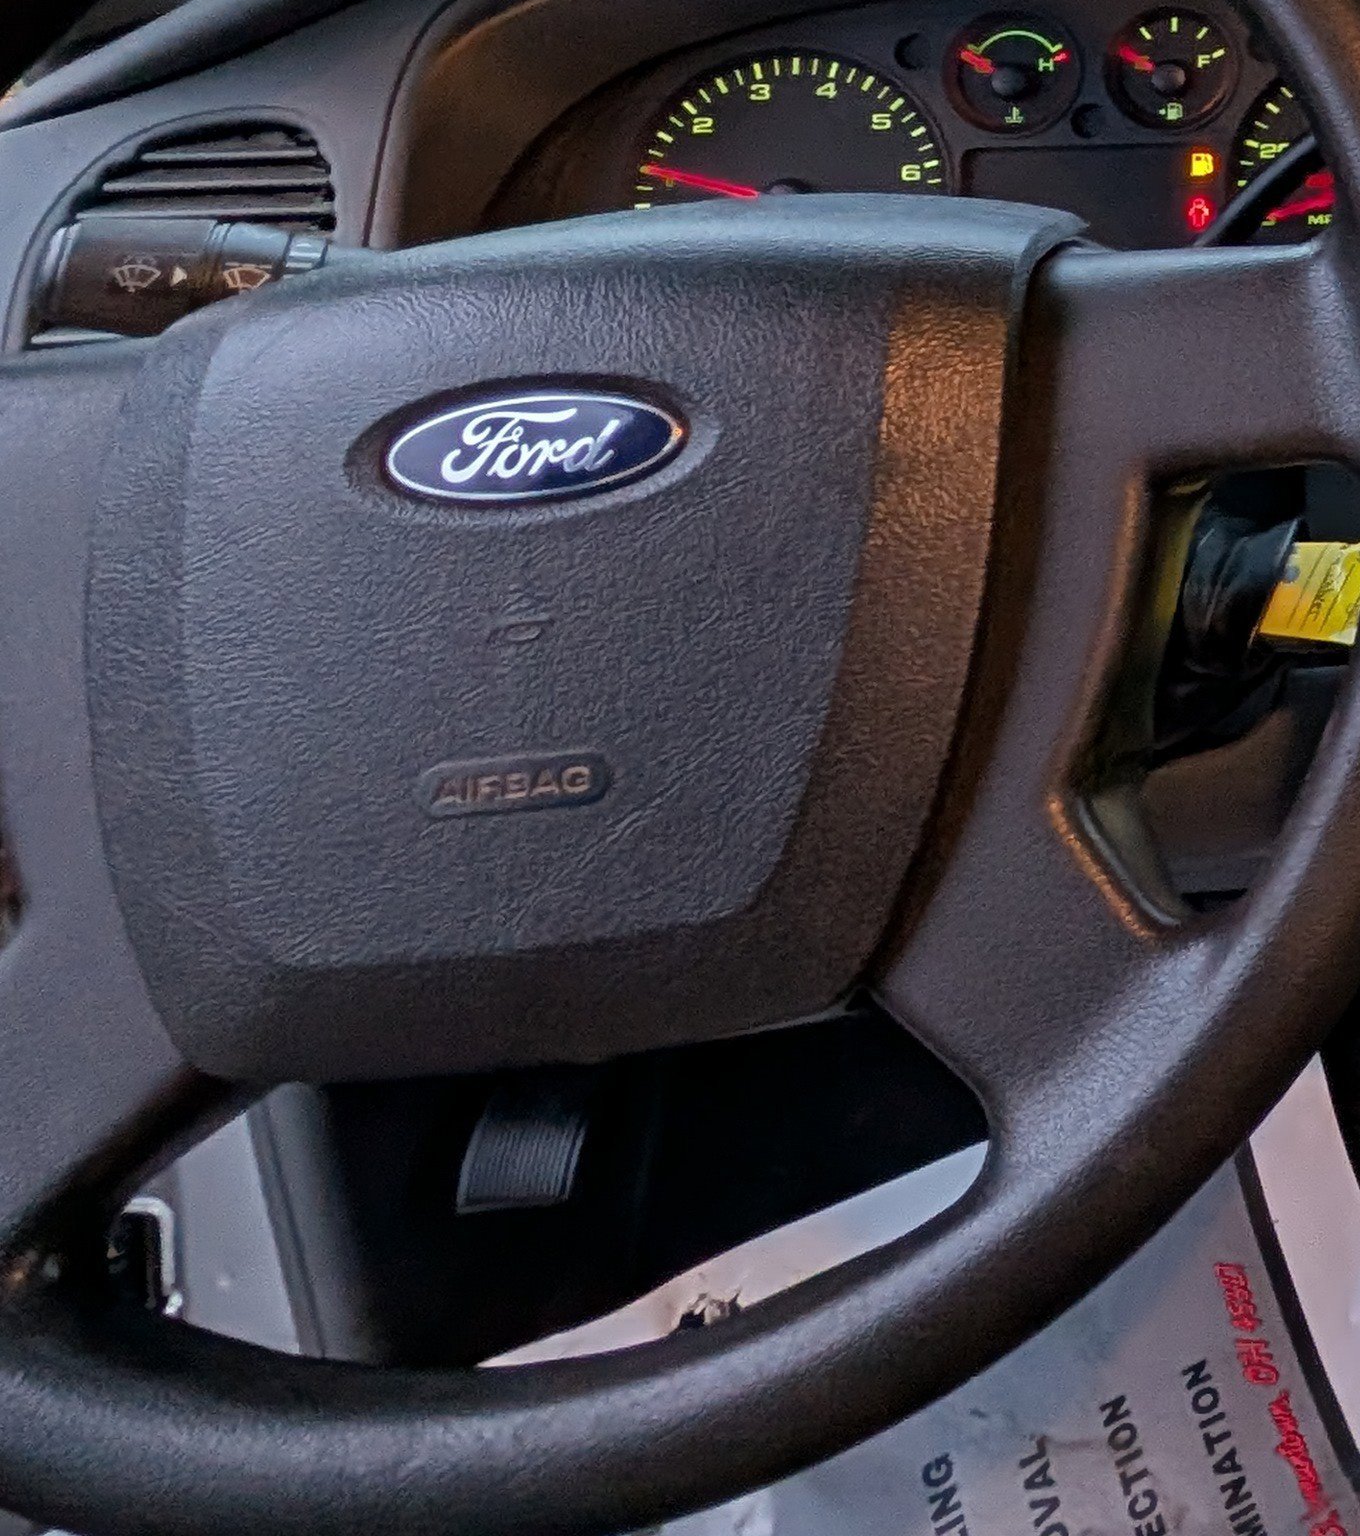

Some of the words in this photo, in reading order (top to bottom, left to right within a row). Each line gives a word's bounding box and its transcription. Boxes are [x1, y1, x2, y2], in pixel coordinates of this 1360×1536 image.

[1038, 57, 1054, 73] H
[1197, 54, 1211, 68] F
[750, 83, 771, 101] 3
[815, 82, 837, 99] 4
[691, 117, 714, 134] 2
[871, 113, 892, 130] 5
[900, 165, 921, 181] 6
[440, 406, 620, 484] Ford
[430, 763, 593, 806] AIRBAG
[1235, 1336, 1280, 1386] OH
[920, 1451, 968, 1536] ING
